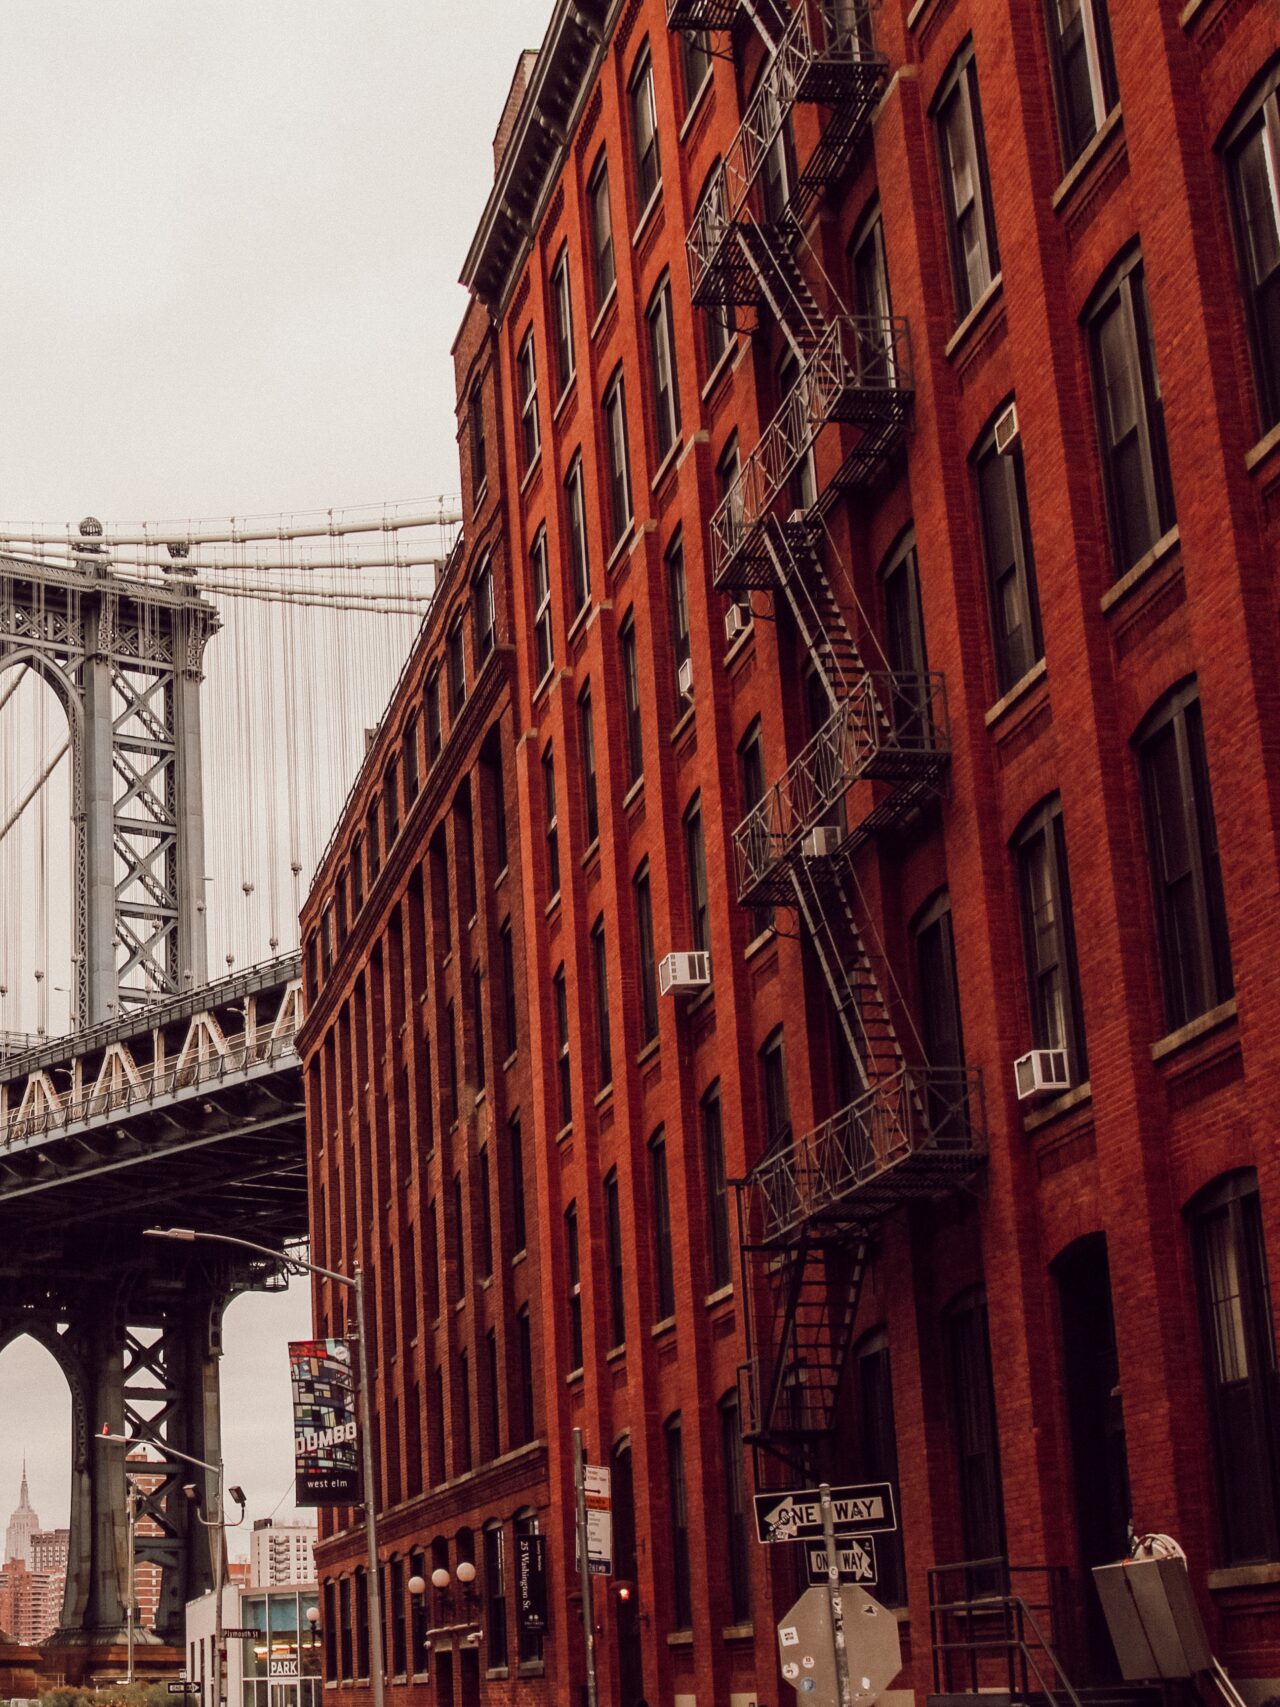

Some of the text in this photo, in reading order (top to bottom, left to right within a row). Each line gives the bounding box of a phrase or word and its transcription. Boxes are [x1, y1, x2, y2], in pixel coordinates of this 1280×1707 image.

[295, 1421, 357, 1455] DUMBO
[307, 1479, 348, 1489] west elm
[778, 1505, 816, 1526] ONE
[834, 1500, 874, 1521] WAY
[520, 1541, 529, 1551] 25
[815, 1551, 863, 1571] ON WAY
[519, 1552, 530, 1599] Washington
[224, 1630, 251, 1638] Plymouth
[270, 1660, 298, 1674] PARK
